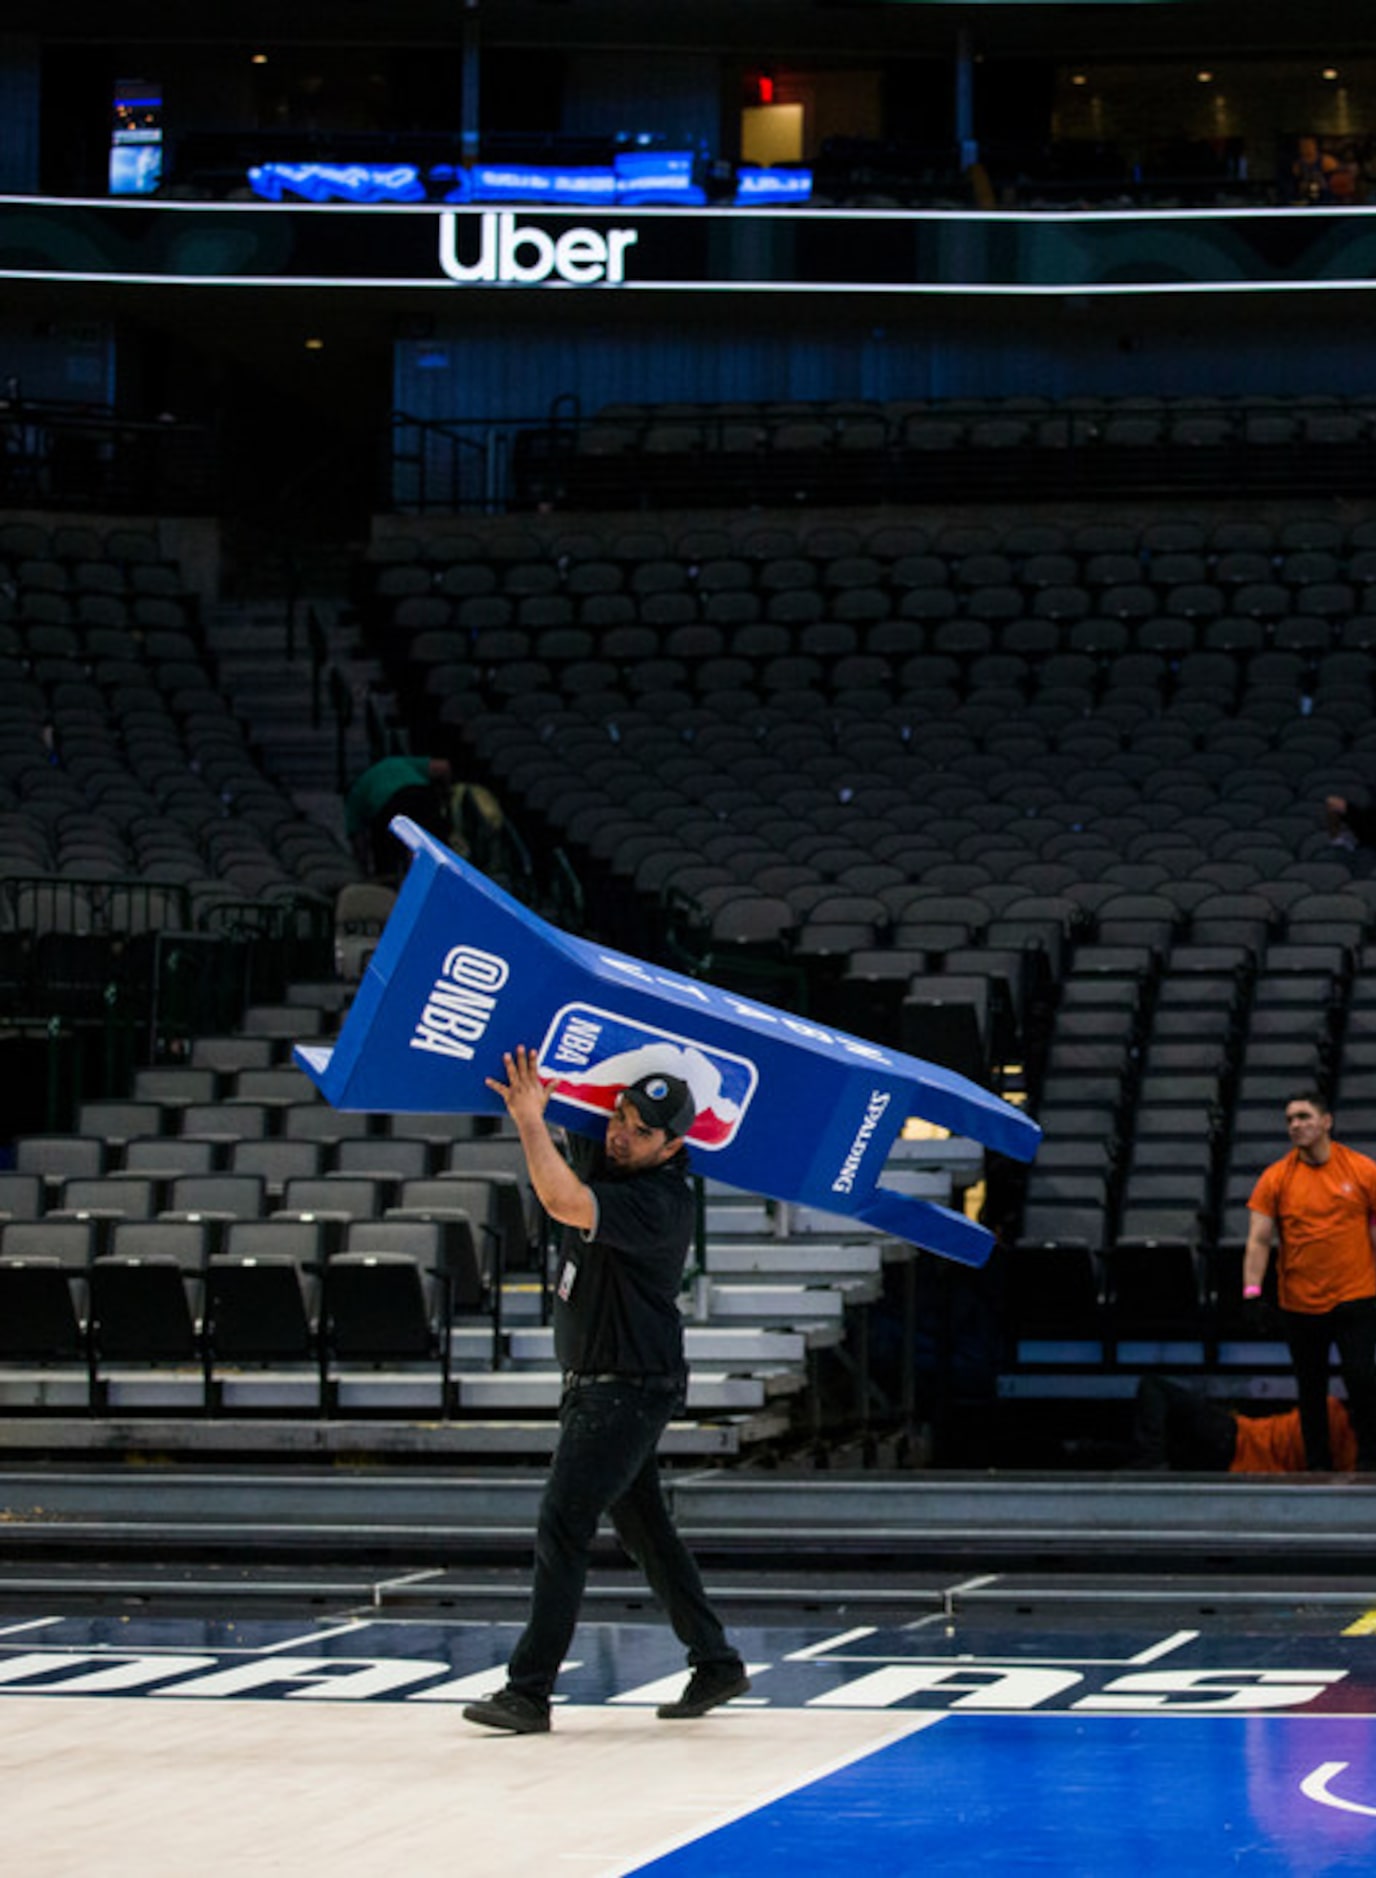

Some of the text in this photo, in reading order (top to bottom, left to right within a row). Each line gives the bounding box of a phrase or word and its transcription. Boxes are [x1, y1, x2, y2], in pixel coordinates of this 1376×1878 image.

[438, 211, 638, 283] Uber
[408, 943, 510, 1061] @NBA
[553, 1016, 603, 1066] NBA
[831, 1088, 892, 1195] SPALDING
[0, 1652, 1350, 1710] DALLAS
